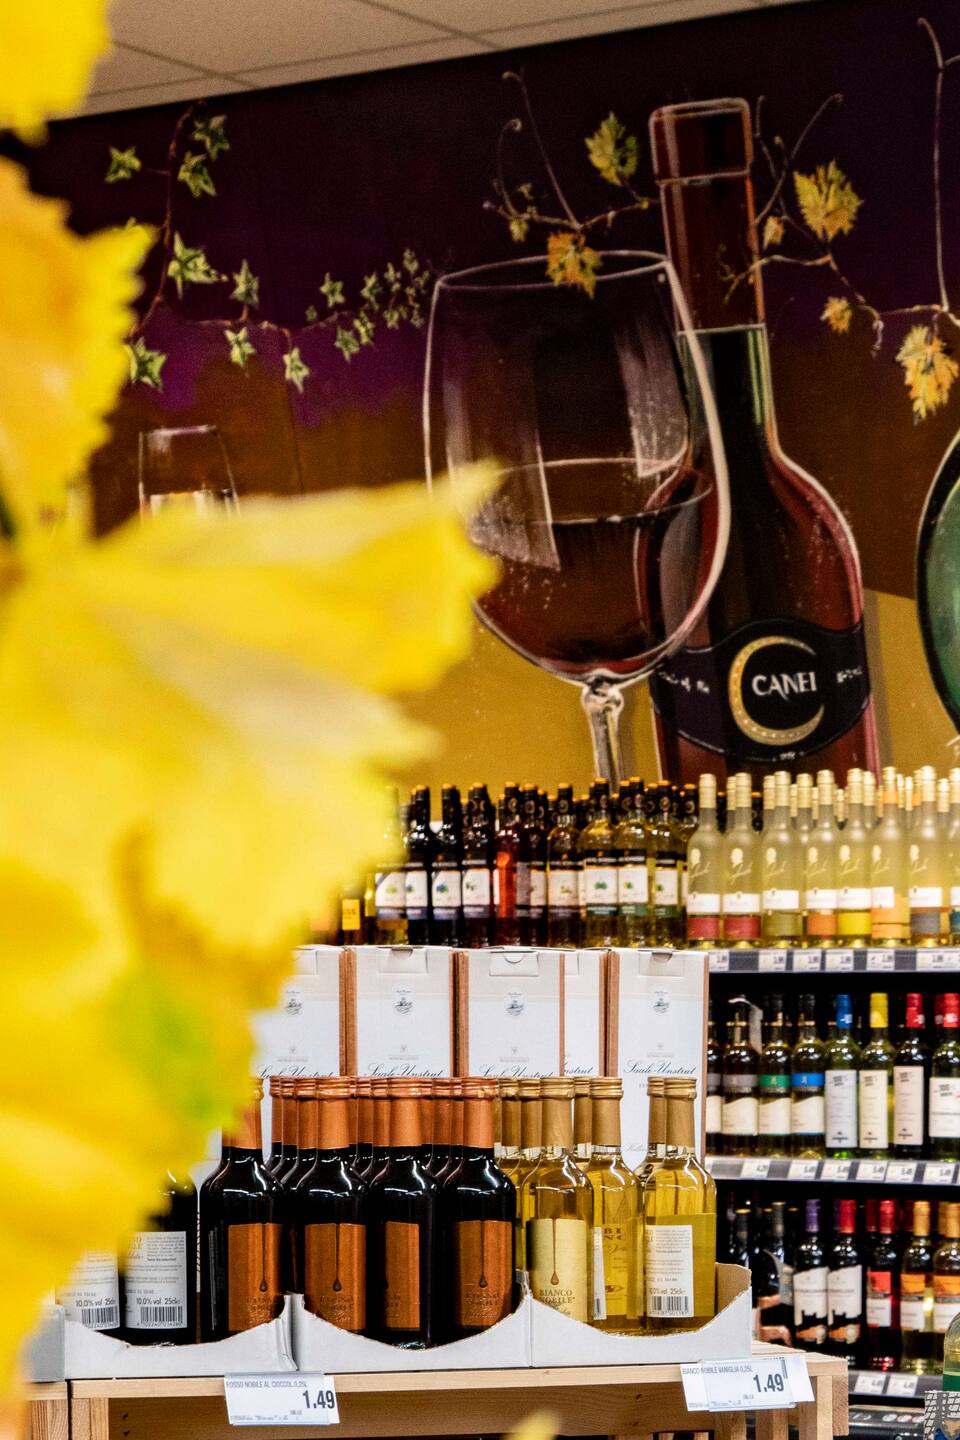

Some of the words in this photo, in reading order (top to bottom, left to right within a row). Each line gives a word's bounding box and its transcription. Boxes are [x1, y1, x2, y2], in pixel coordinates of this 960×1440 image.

[752, 672, 817, 700] CANEI
[539, 1289, 573, 1297] BIANCO
[753, 1373, 784, 1393] 1.49
[302, 1390, 335, 1409] 1.49
